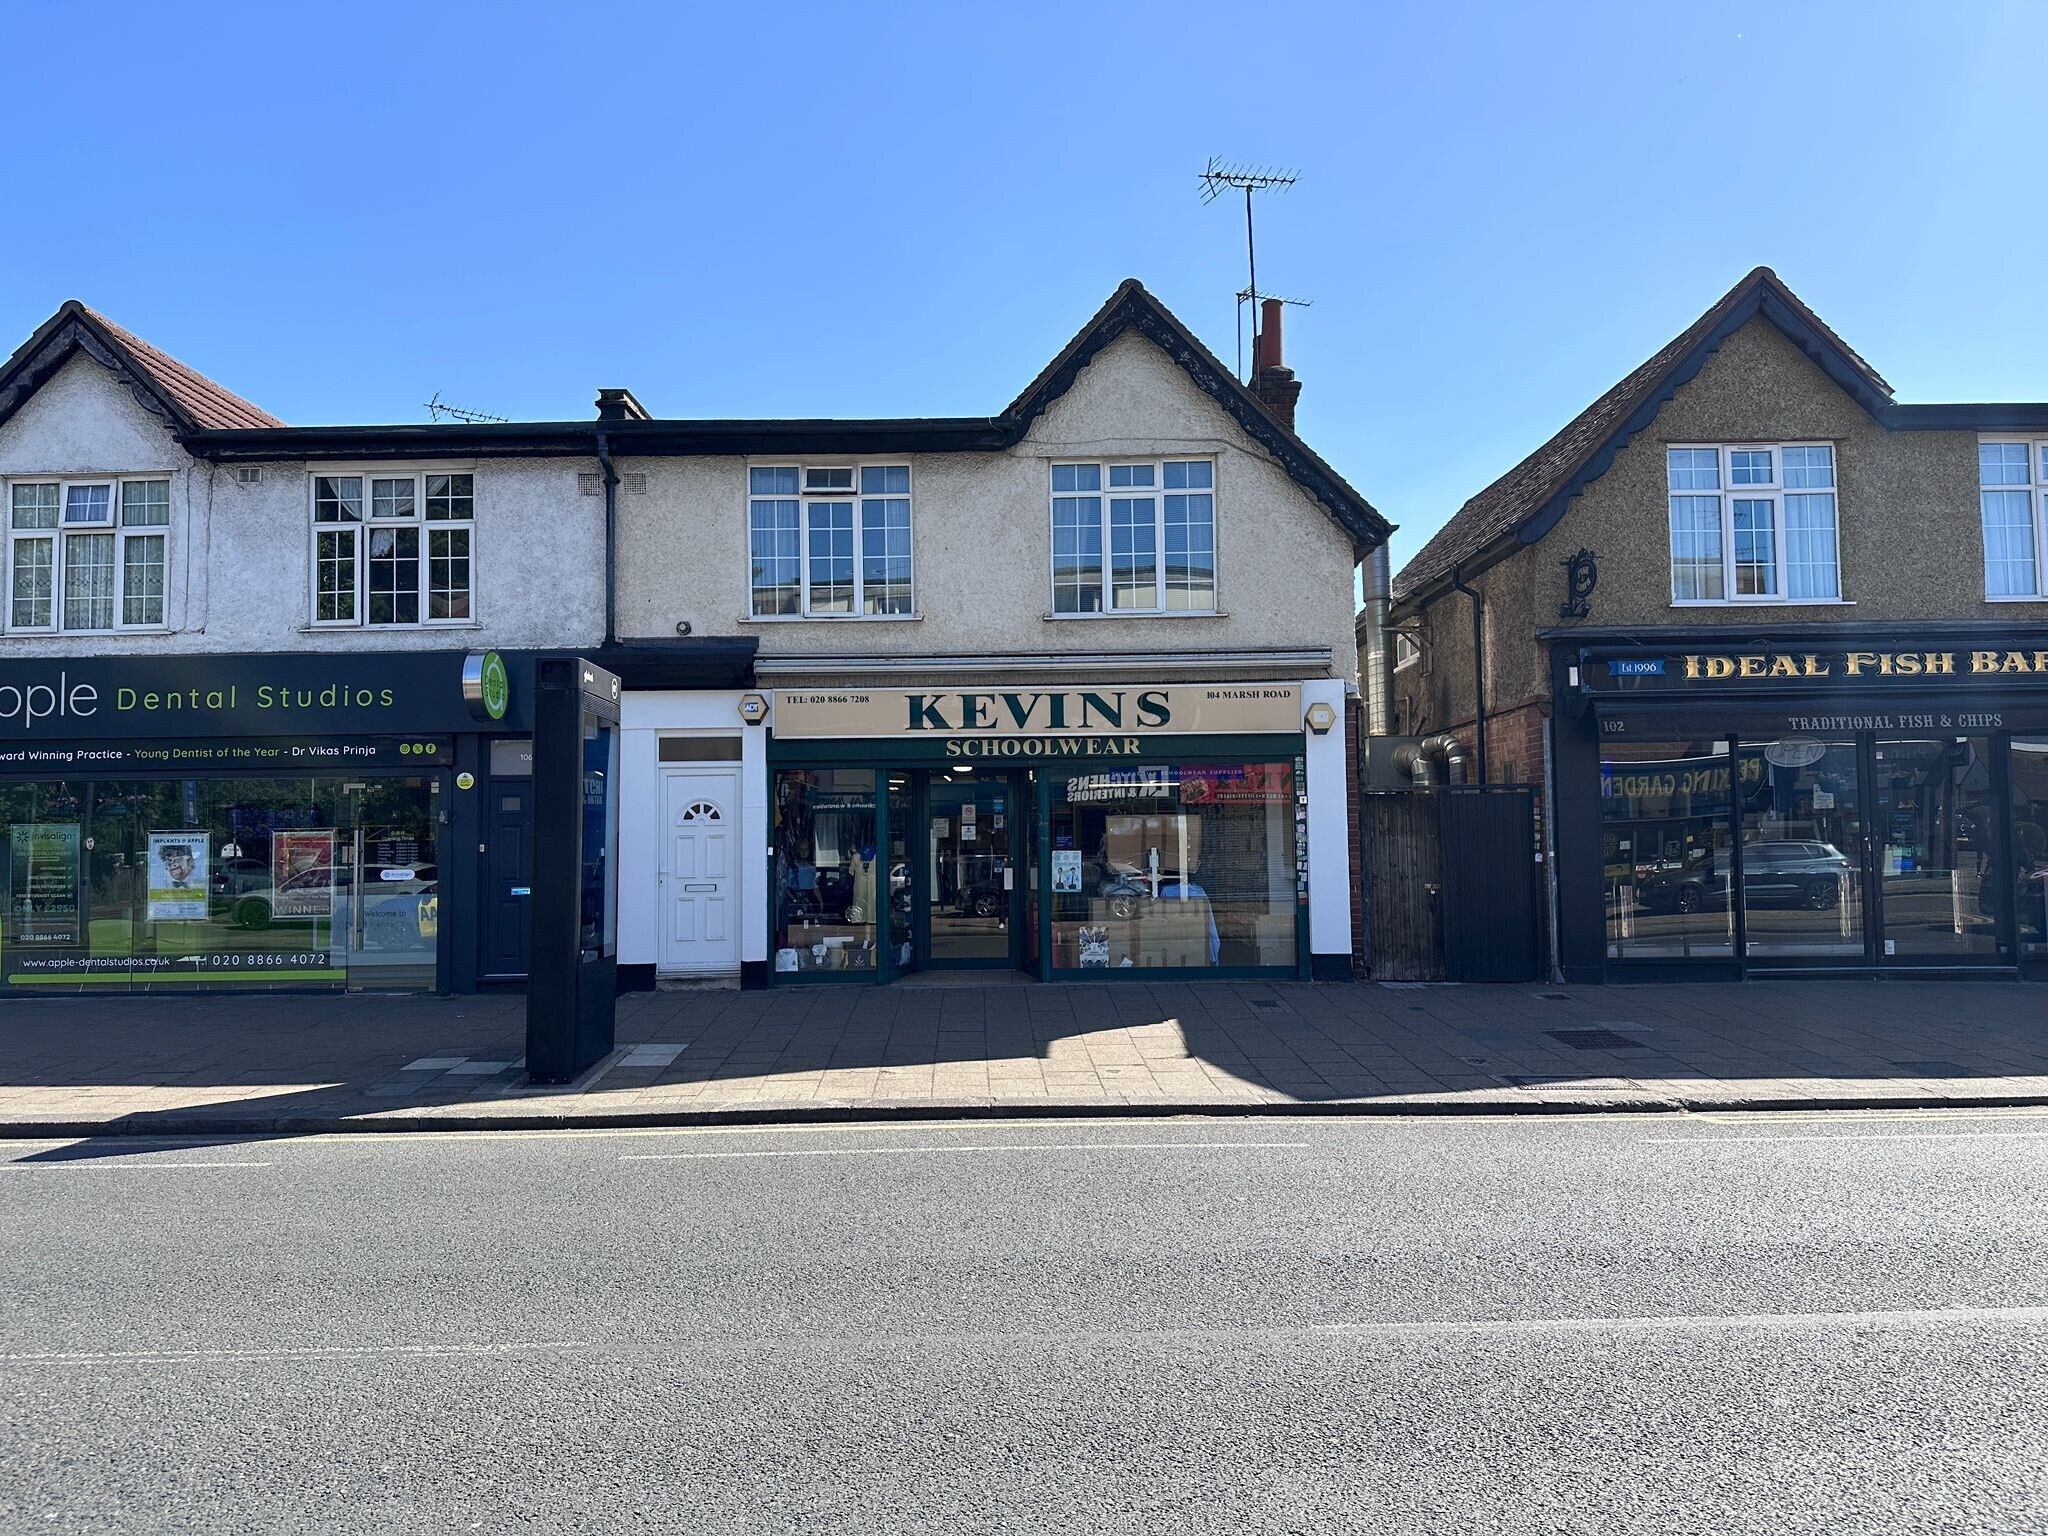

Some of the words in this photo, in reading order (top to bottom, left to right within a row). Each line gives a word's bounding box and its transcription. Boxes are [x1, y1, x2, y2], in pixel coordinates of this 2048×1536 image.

[1634, 662, 1657, 672] 1996
[1683, 653, 1831, 680] IDEAL
[1845, 651, 1955, 676] FISH
[117, 685, 236, 711] Dental
[257, 683, 394, 708] Studios
[785, 696, 808, 704] TEL:
[810, 695, 826, 704] 020
[828, 695, 848, 704] 8866
[850, 695, 870, 704] 7208
[1206, 690, 1220, 699] 104
[1222, 690, 1260, 699] MARSH
[1263, 690, 1291, 699] ROAD
[744, 702, 759, 712] ADT
[904, 690, 1171, 731] KEVINS
[1603, 721, 1625, 732] 102
[1788, 715, 1894, 731] TRADITIONAL
[1898, 715, 1934, 728] FISH
[1940, 715, 1952, 728] &
[1958, 714, 2003, 728] CHIPS
[28, 750, 73, 762] Winning
[77, 750, 123, 759] Practice
[135, 749, 169, 760] Young
[173, 748, 213, 758] Dentist
[216, 747, 229, 757] of
[232, 747, 251, 757] the
[254, 747, 280, 757] Year
[292, 746, 305, 756] Dr
[309, 746, 340, 756] Vikas
[343, 745, 376, 757] Prinja
[946, 737, 1142, 757] SCHOOLWEAR
[274, 905, 330, 914] WINNER
[212, 954, 240, 966] 020
[247, 954, 283, 966] 8866
[290, 953, 325, 965] 4072
